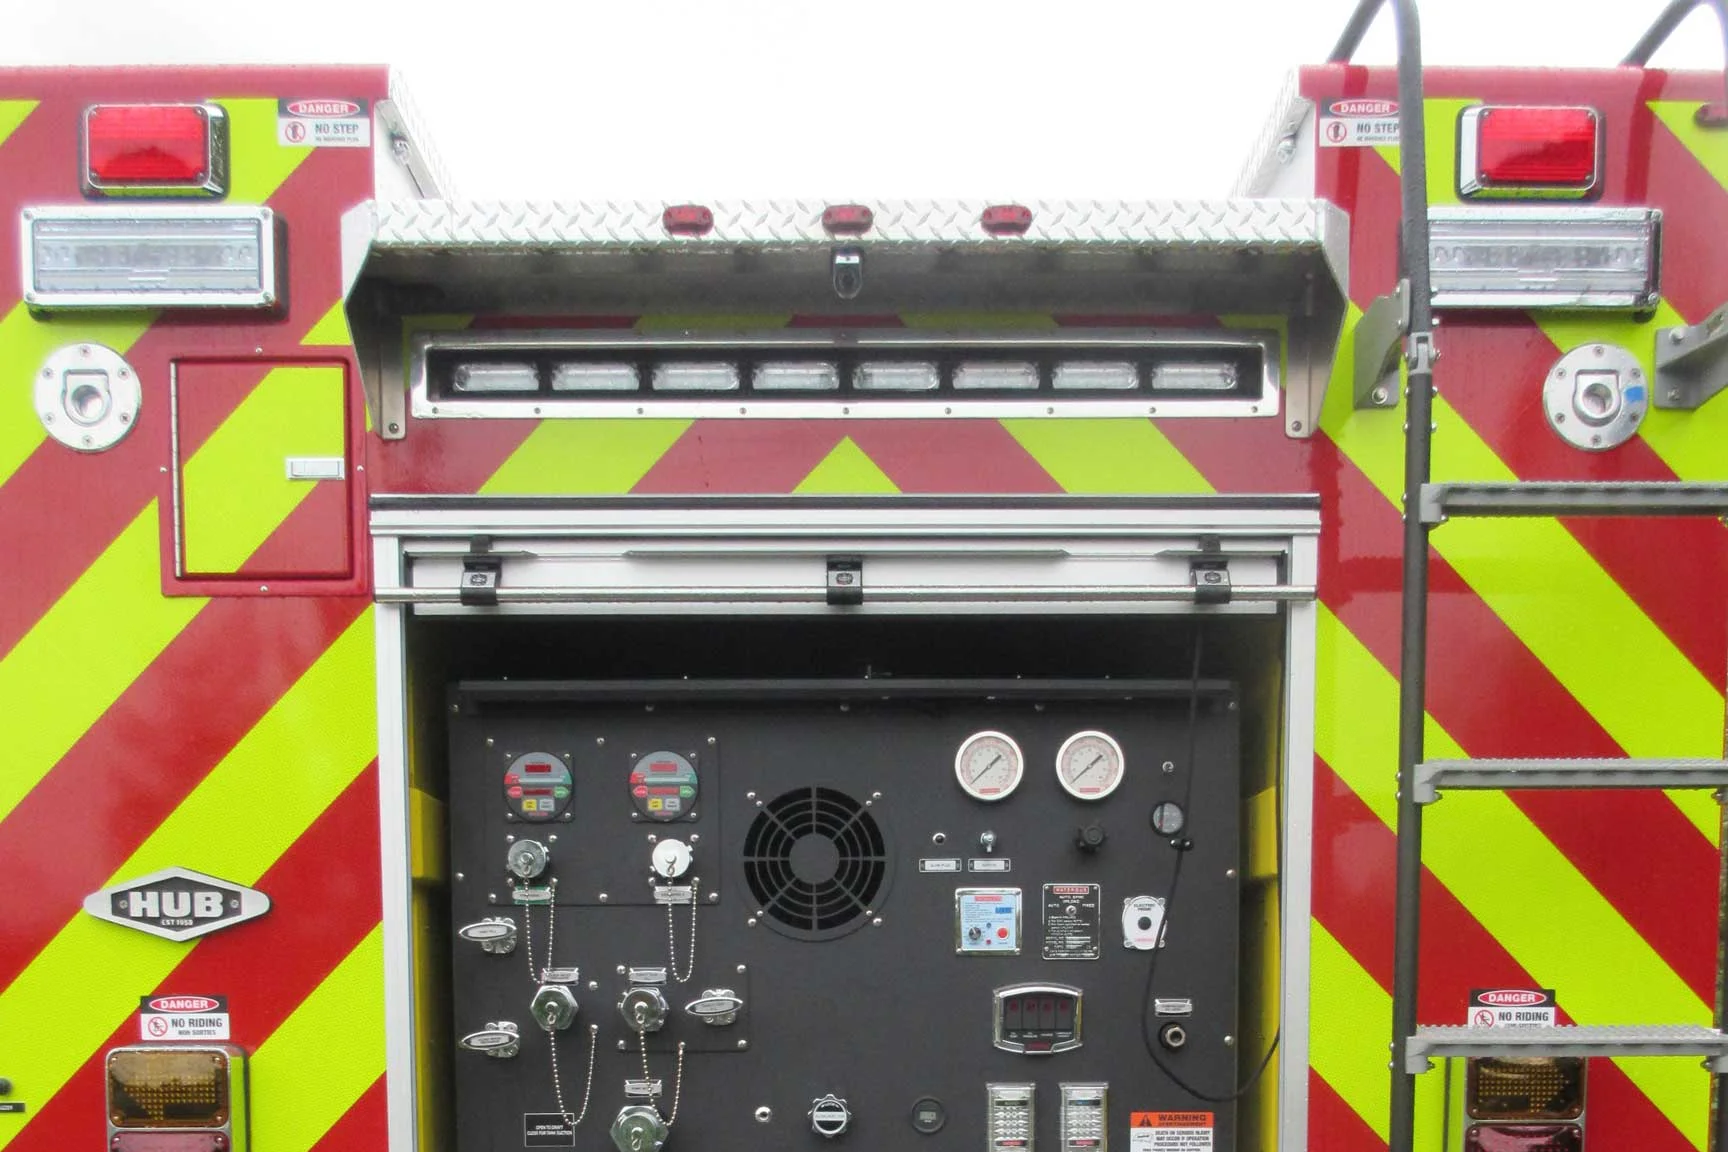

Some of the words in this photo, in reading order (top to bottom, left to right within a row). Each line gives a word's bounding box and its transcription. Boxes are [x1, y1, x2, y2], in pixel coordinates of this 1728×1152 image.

[298, 103, 349, 114] DANGER
[1340, 103, 1390, 114] DANGER
[315, 123, 330, 134] NO
[333, 123, 359, 134] STEP
[1356, 123, 1371, 134] NO
[1374, 123, 1399, 134] STEP
[129, 891, 224, 918] HUB
[1488, 994, 1536, 1003] DANGER
[160, 1000, 209, 1009] DANGER
[1498, 1012, 1512, 1021] NO
[1515, 1012, 1549, 1021] RIDING
[171, 1019, 185, 1028] NO
[188, 1019, 223, 1028] RIDING
